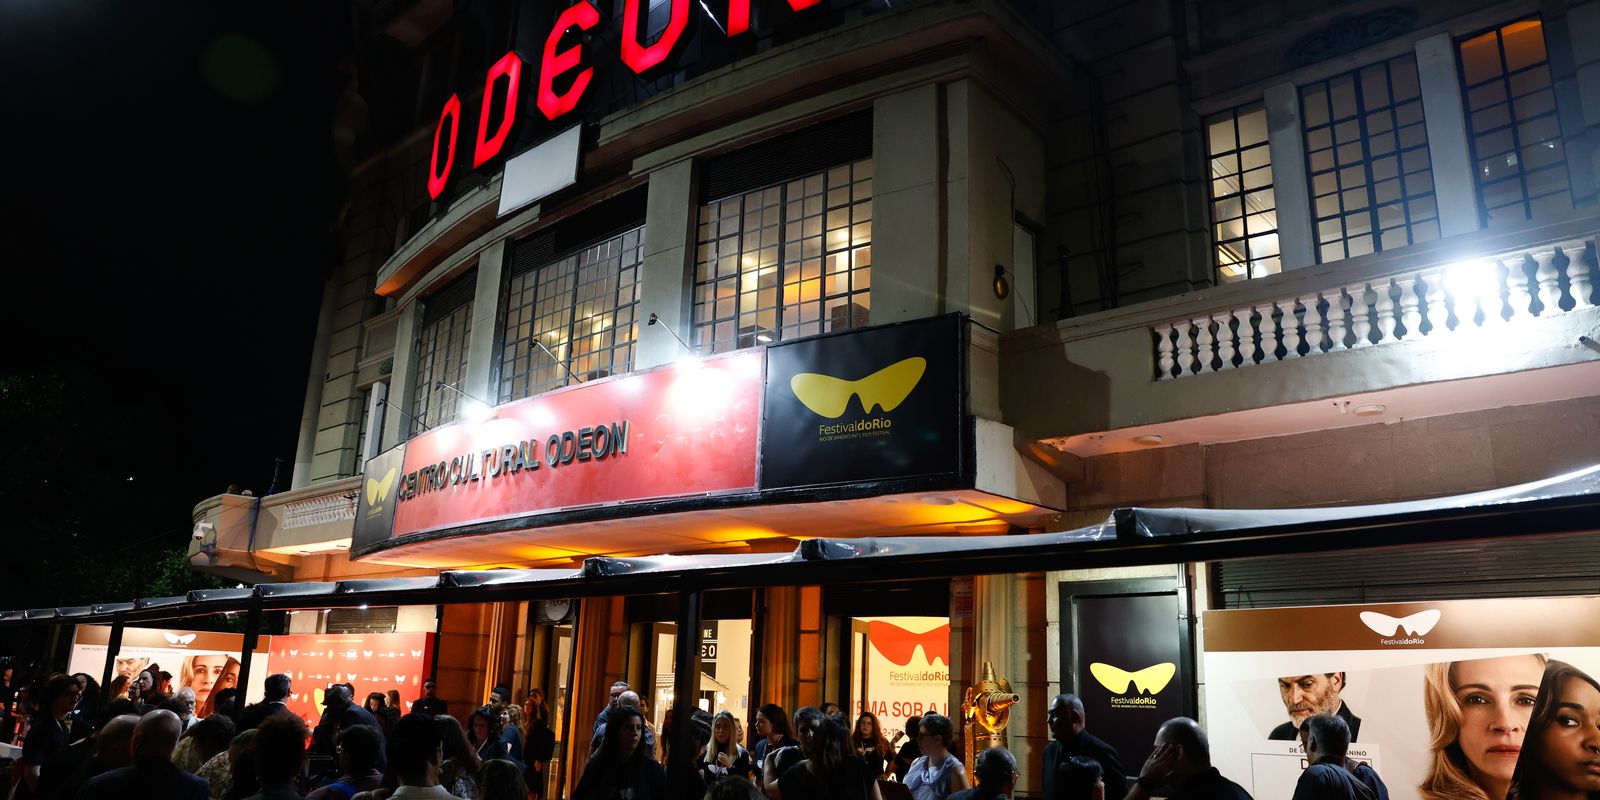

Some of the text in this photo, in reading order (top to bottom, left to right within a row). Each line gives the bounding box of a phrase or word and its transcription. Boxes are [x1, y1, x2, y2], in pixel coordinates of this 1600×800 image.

[819, 417, 892, 435] FestivaldoRio
[398, 420, 630, 502] CENTRO CULTURAL ODEON
[1381, 637, 1425, 645] FestivaldoRio
[1111, 696, 1157, 705] FestivaldoRio
[892, 701, 924, 718] SOB
